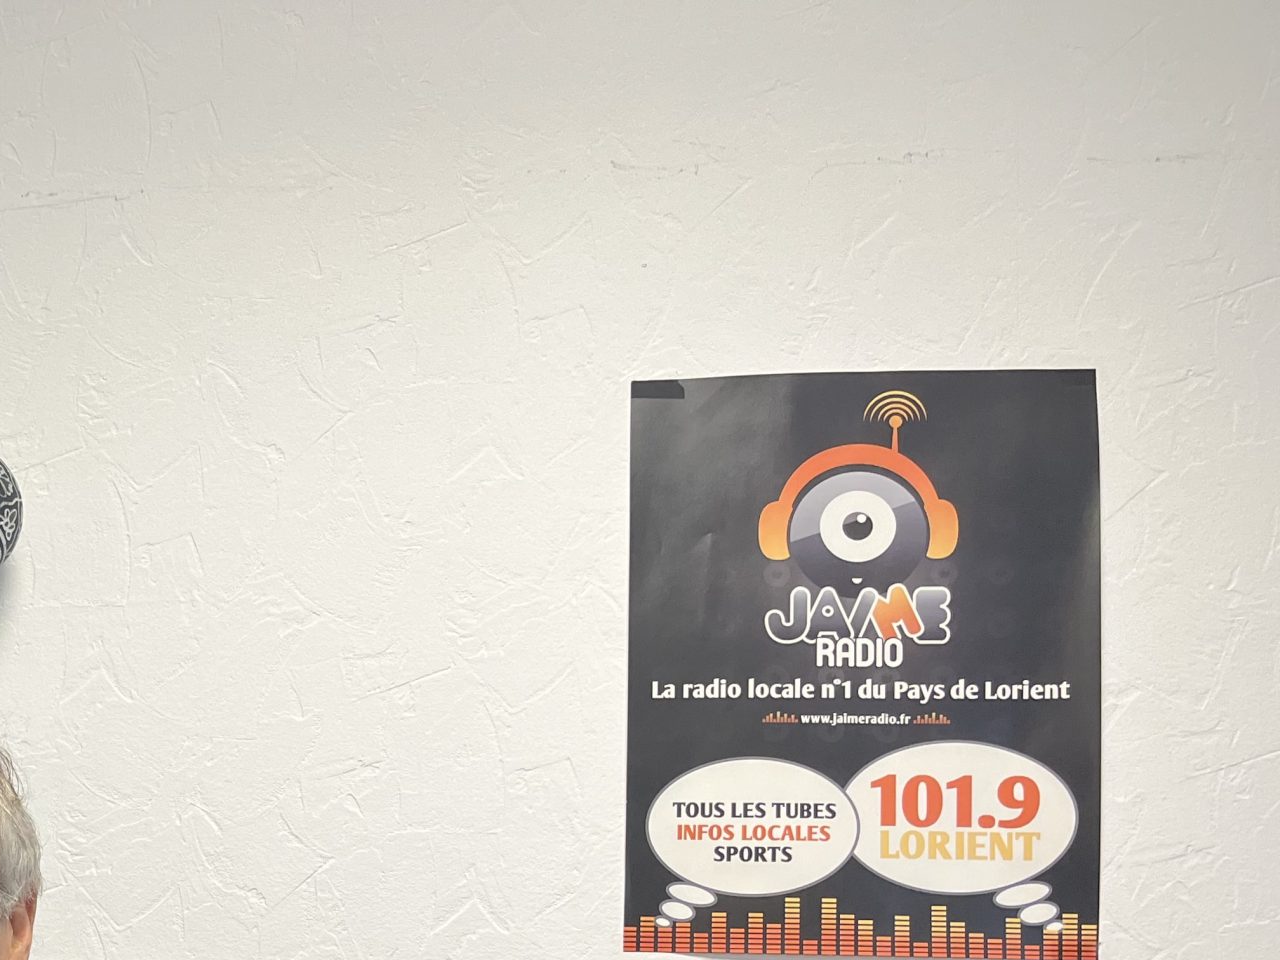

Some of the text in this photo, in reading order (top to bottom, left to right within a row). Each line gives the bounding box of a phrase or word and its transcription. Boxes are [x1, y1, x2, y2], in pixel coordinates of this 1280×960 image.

[816, 637, 903, 668] RADIO
[652, 680, 676, 699] La
[683, 678, 741, 699] radio
[748, 679, 815, 699] locale
[858, 679, 886, 700] du
[894, 680, 946, 704] Pays
[950, 679, 978, 700] de
[984, 679, 1070, 700] Lorient
[801, 713, 911, 726] www.jaimeradio.fr
[672, 802, 836, 820] TOUS LES TUBES
[870, 774, 1040, 828] 101.9
[677, 825, 831, 842] INFOS LOCALES
[713, 846, 792, 863] SPORTS
[880, 830, 1040, 861] LORIENT
